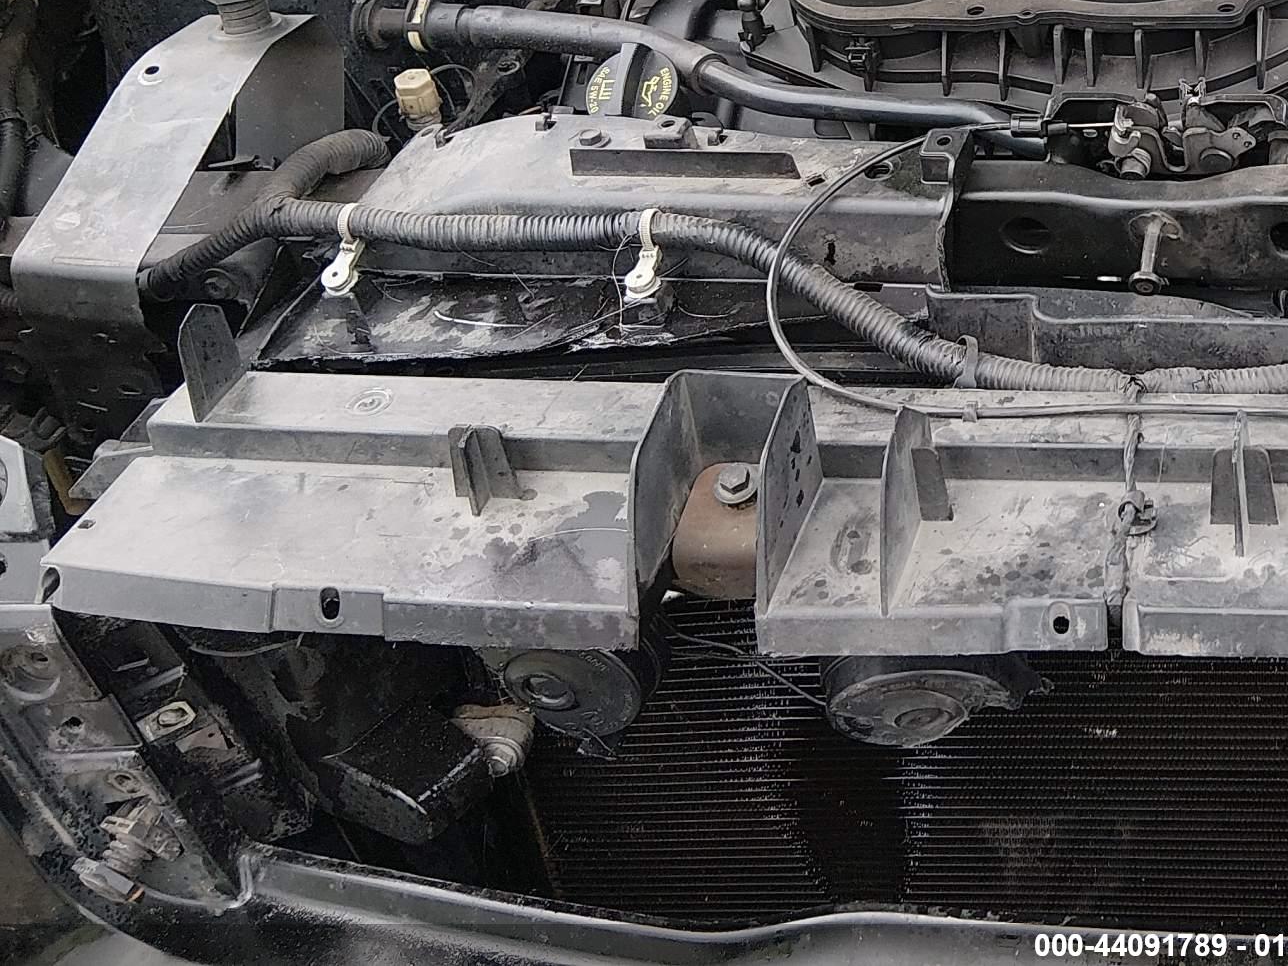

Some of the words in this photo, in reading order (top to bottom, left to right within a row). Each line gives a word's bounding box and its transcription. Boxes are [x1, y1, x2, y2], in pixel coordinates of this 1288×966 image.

[593, 66, 610, 84] SAE
[659, 67, 672, 101] ENGINE
[589, 85, 599, 113] 5W-20
[647, 102, 665, 116] OIL
